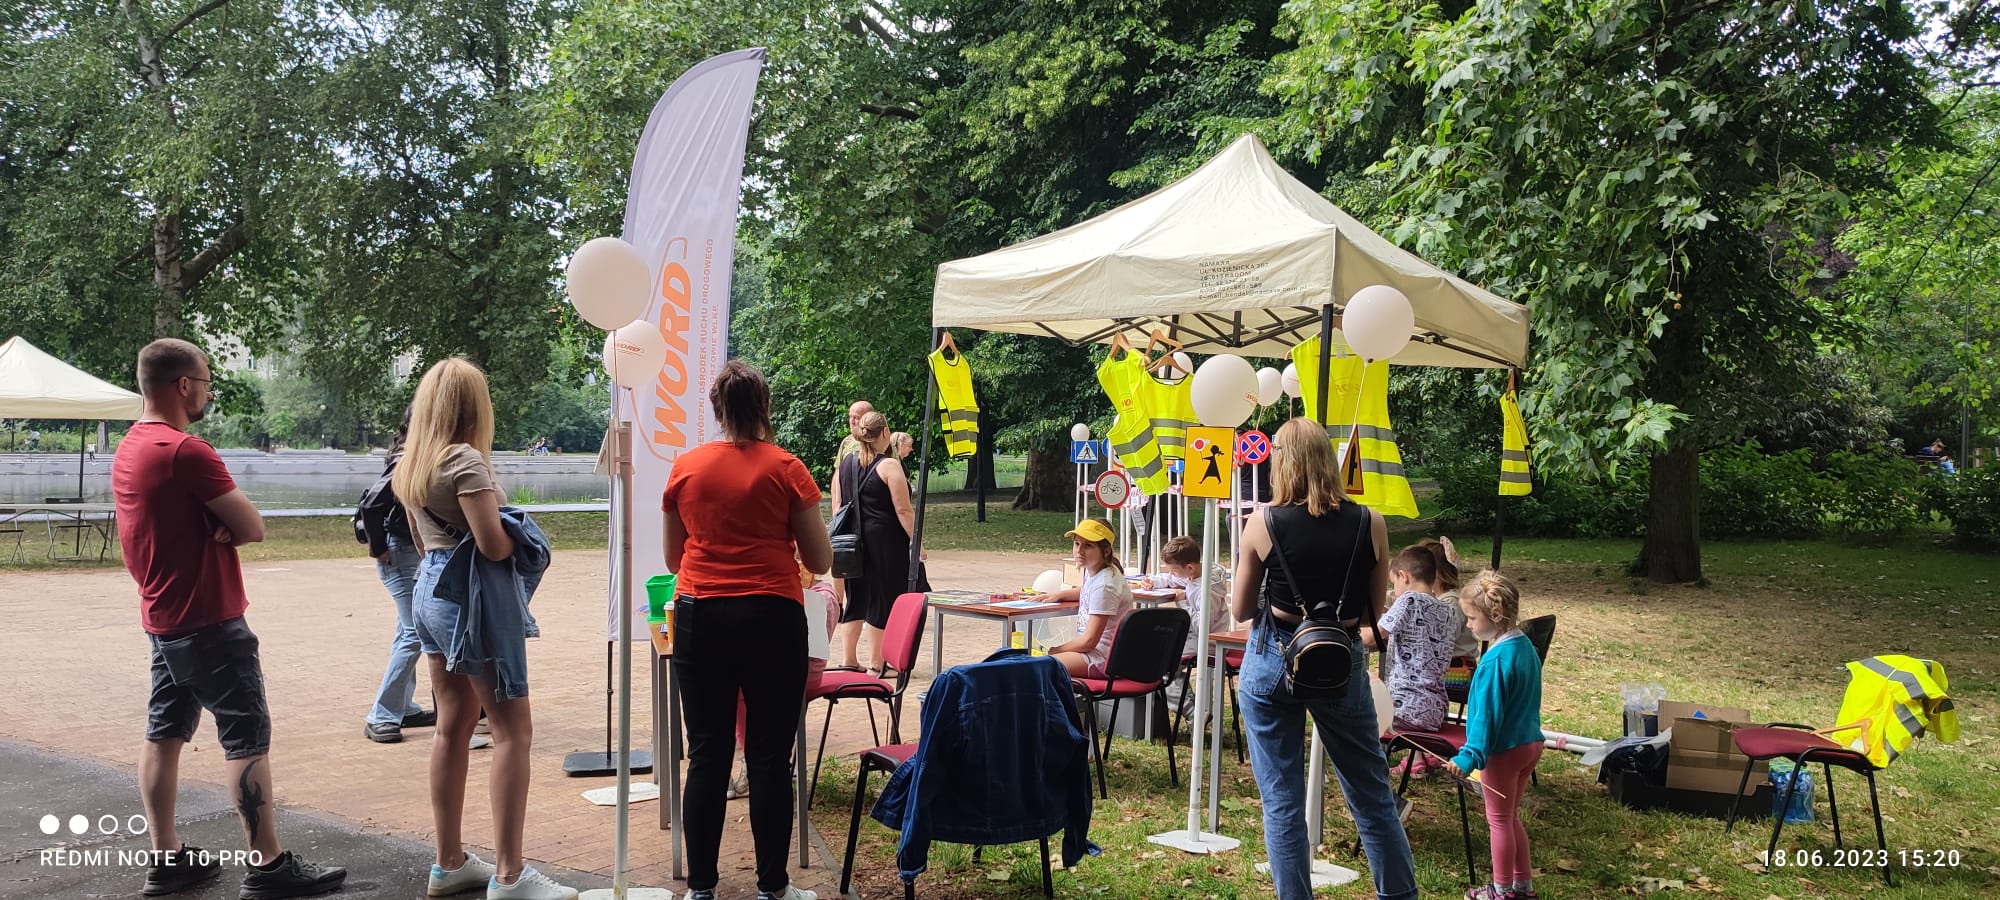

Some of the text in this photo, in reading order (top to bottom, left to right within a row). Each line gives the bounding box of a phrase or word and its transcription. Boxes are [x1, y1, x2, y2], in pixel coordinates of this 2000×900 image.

[702, 238, 713, 304] DROGOWEGO
[1212, 264, 1255, 273] KOZIENICKA
[700, 307, 708, 344] RUCHU
[654, 262, 692, 448] WORD
[698, 346, 707, 394] OŚRODEK
